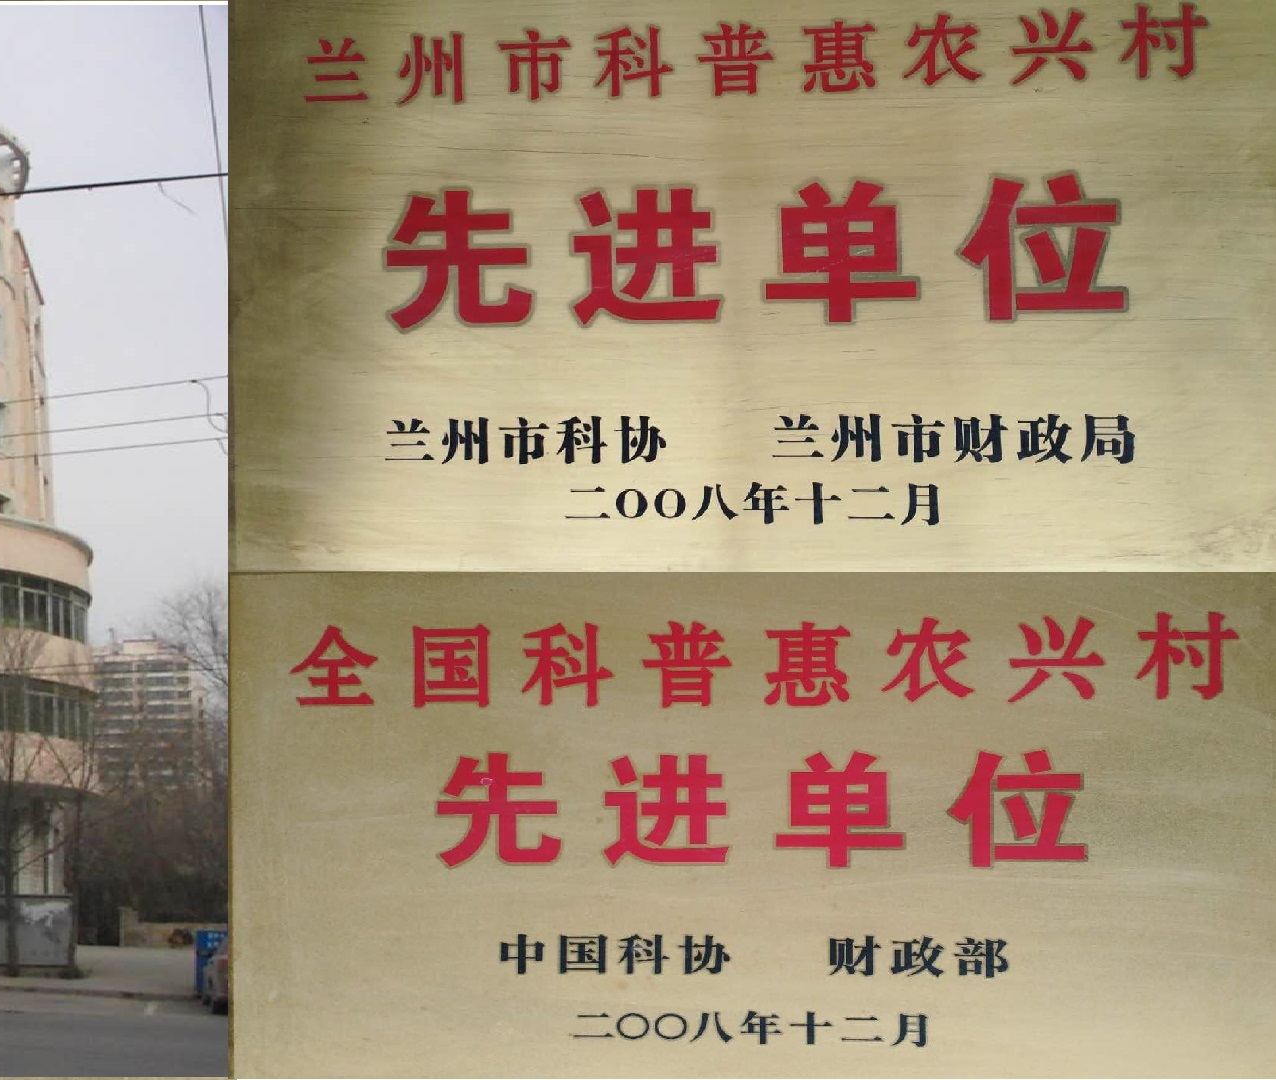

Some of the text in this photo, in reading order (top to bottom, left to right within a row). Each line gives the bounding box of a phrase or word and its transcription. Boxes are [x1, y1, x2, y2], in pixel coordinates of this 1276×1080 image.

[303, 4, 1209, 105] 兰州市科普惠农兴村
[384, 172, 1129, 331] 先进单位
[384, 412, 1137, 465] 兰州市科协 兰州市财政局
[290, 610, 1240, 709] 全国科普惠农兴村
[434, 749, 1088, 870] 先进单位
[497, 933, 1010, 979] 中国科协 财政部
